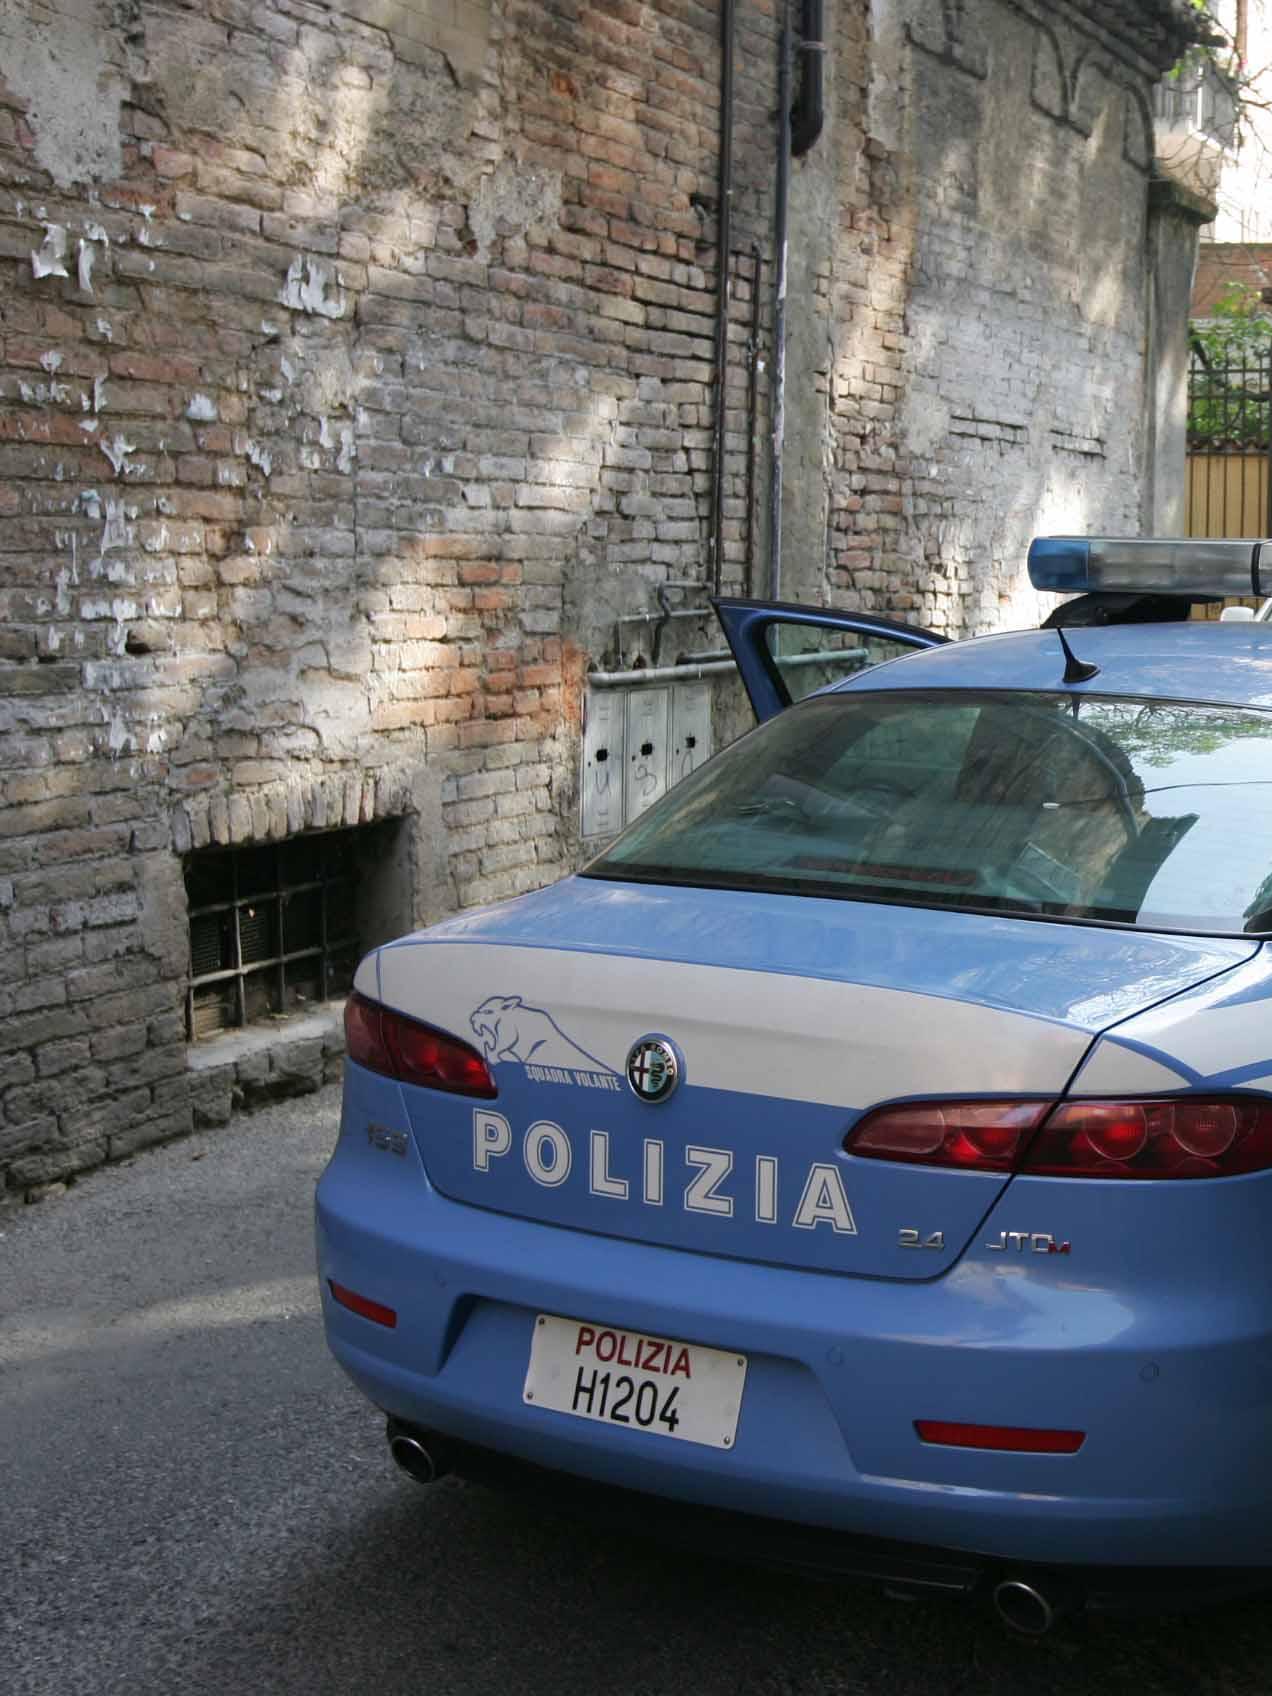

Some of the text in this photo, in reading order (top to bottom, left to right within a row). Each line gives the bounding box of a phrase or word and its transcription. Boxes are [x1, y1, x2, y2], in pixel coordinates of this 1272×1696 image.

[525, 1065, 621, 1091] SQUADRA VOLANTE
[473, 1109, 858, 1234] POLIZIA
[575, 1326, 691, 1379] POLIZIA
[572, 1366, 680, 1432] H1204
